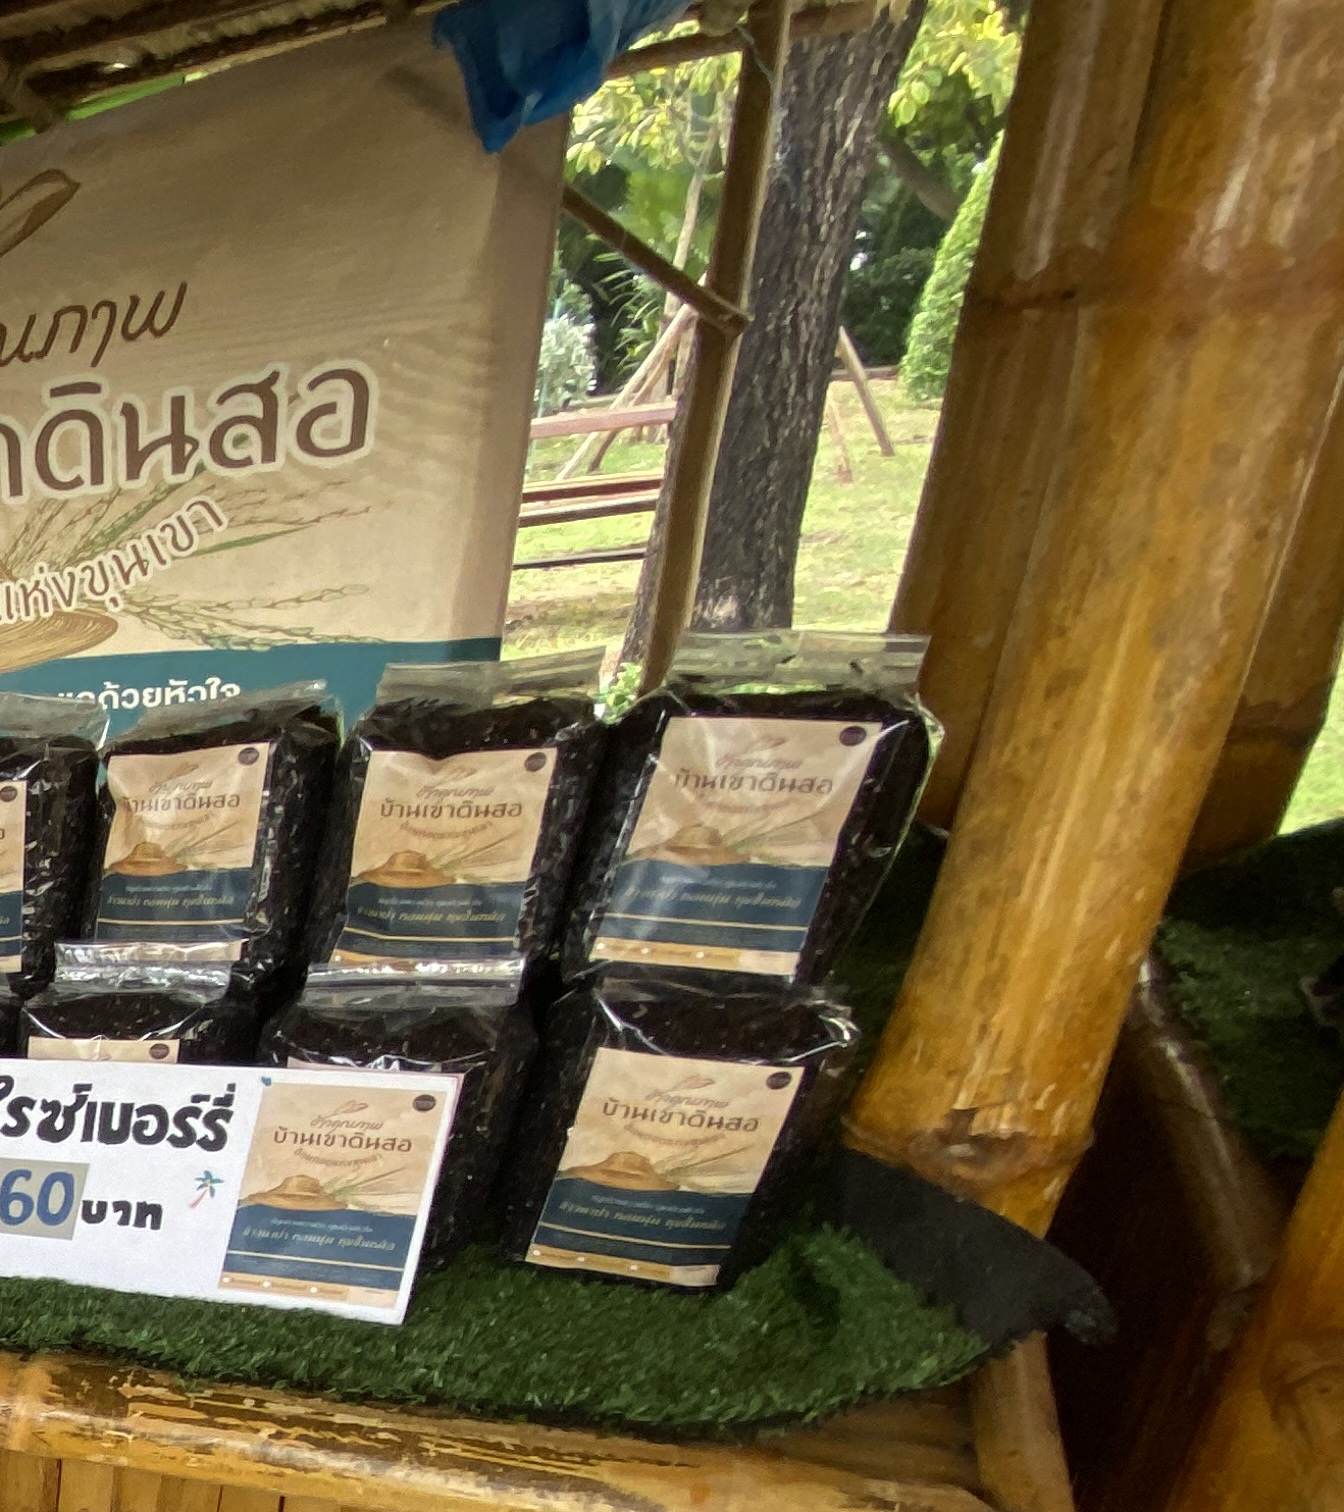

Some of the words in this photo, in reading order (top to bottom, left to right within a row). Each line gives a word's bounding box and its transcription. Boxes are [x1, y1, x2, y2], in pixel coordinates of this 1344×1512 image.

[380, 798, 523, 818] บ้านเขาดินสอ
[601, 1097, 761, 1132] บ้านเขาดินสอ
[273, 1127, 412, 1152] บ้านเขาดินสอ
[81, 1199, 162, 1231] บาท
